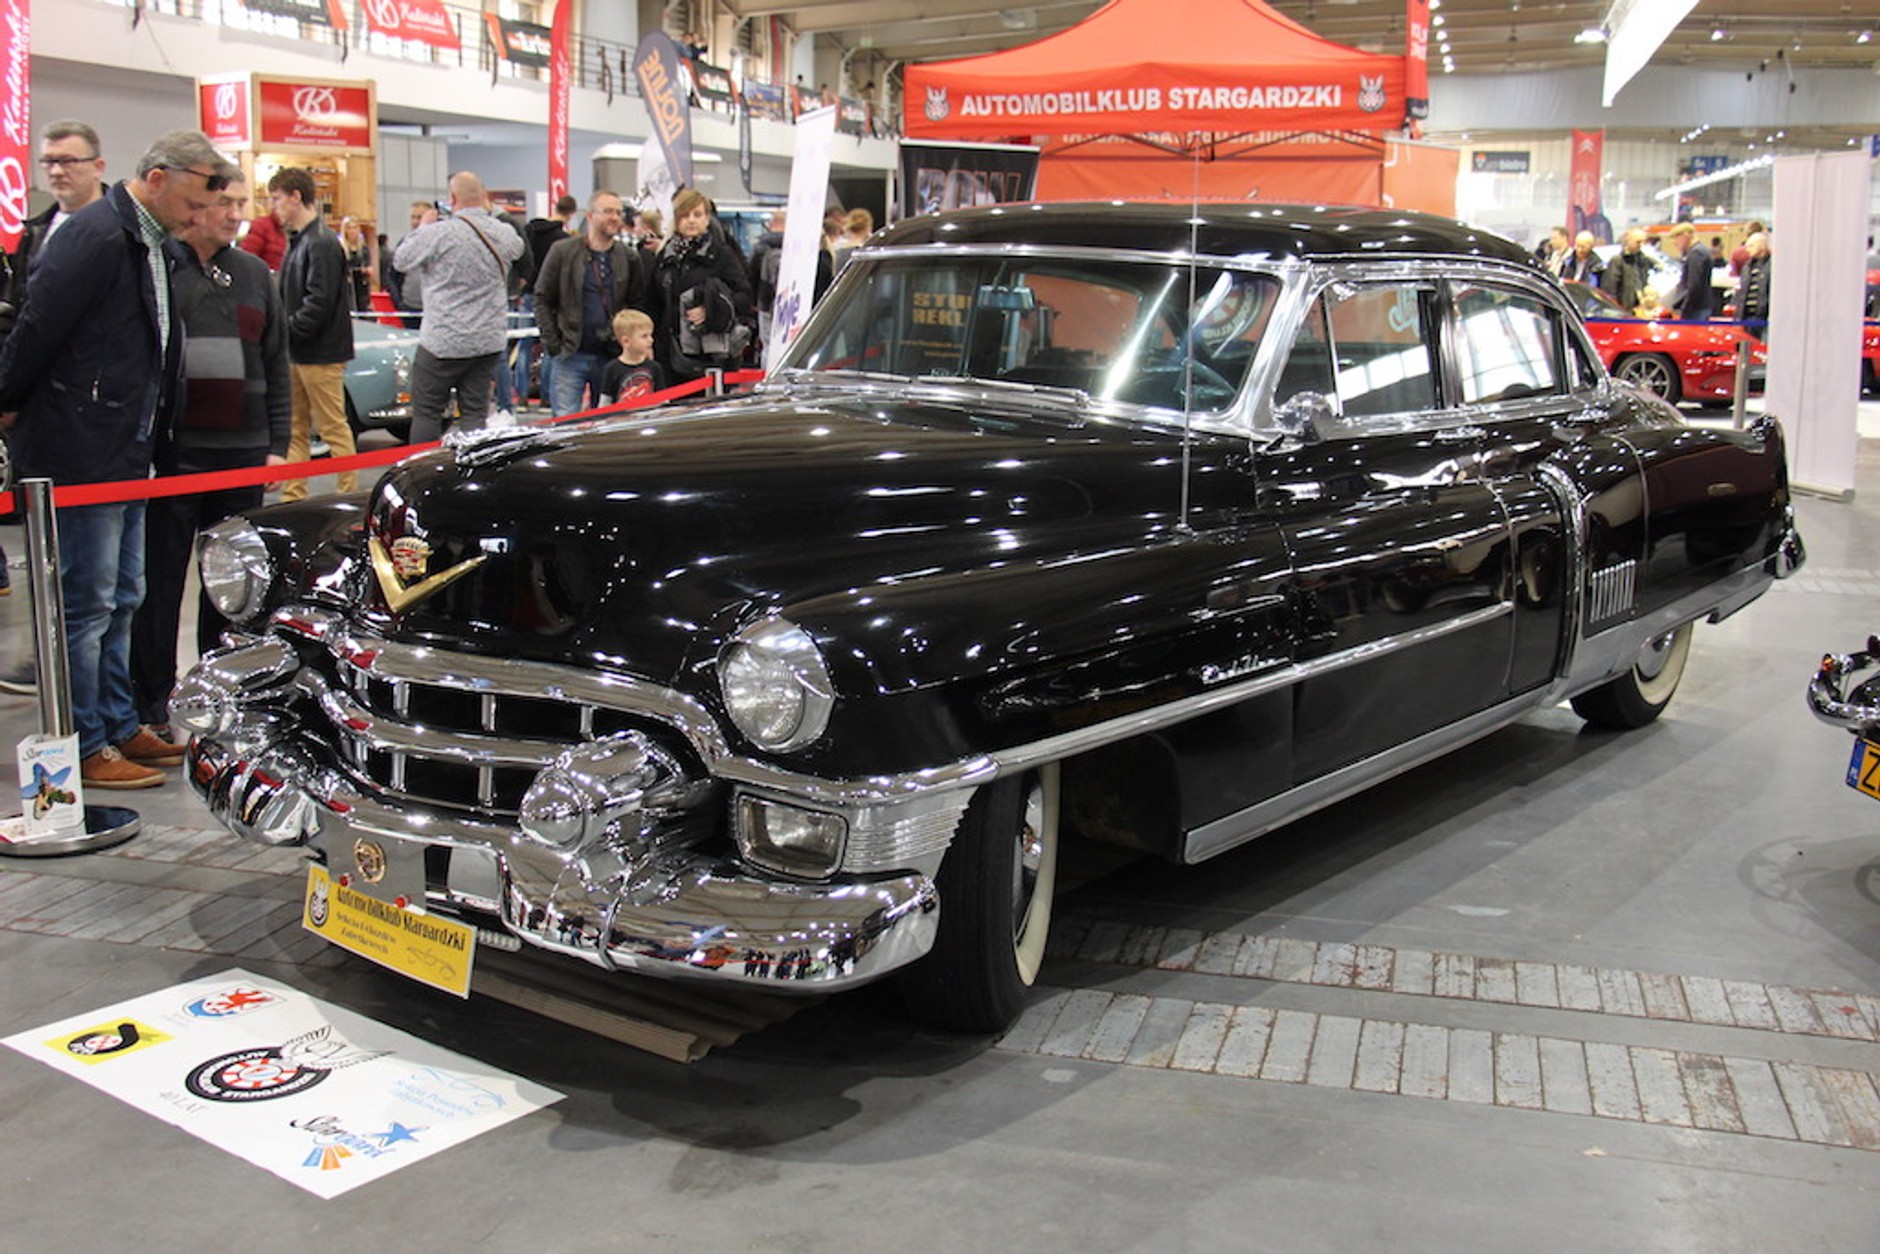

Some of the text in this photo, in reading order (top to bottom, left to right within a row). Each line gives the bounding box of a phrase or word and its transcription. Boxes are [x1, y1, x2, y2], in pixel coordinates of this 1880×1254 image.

[960, 84, 1342, 116] AUTOMOBILKLUB STARGARDZKI
[403, 914, 467, 952] Stargardzki
